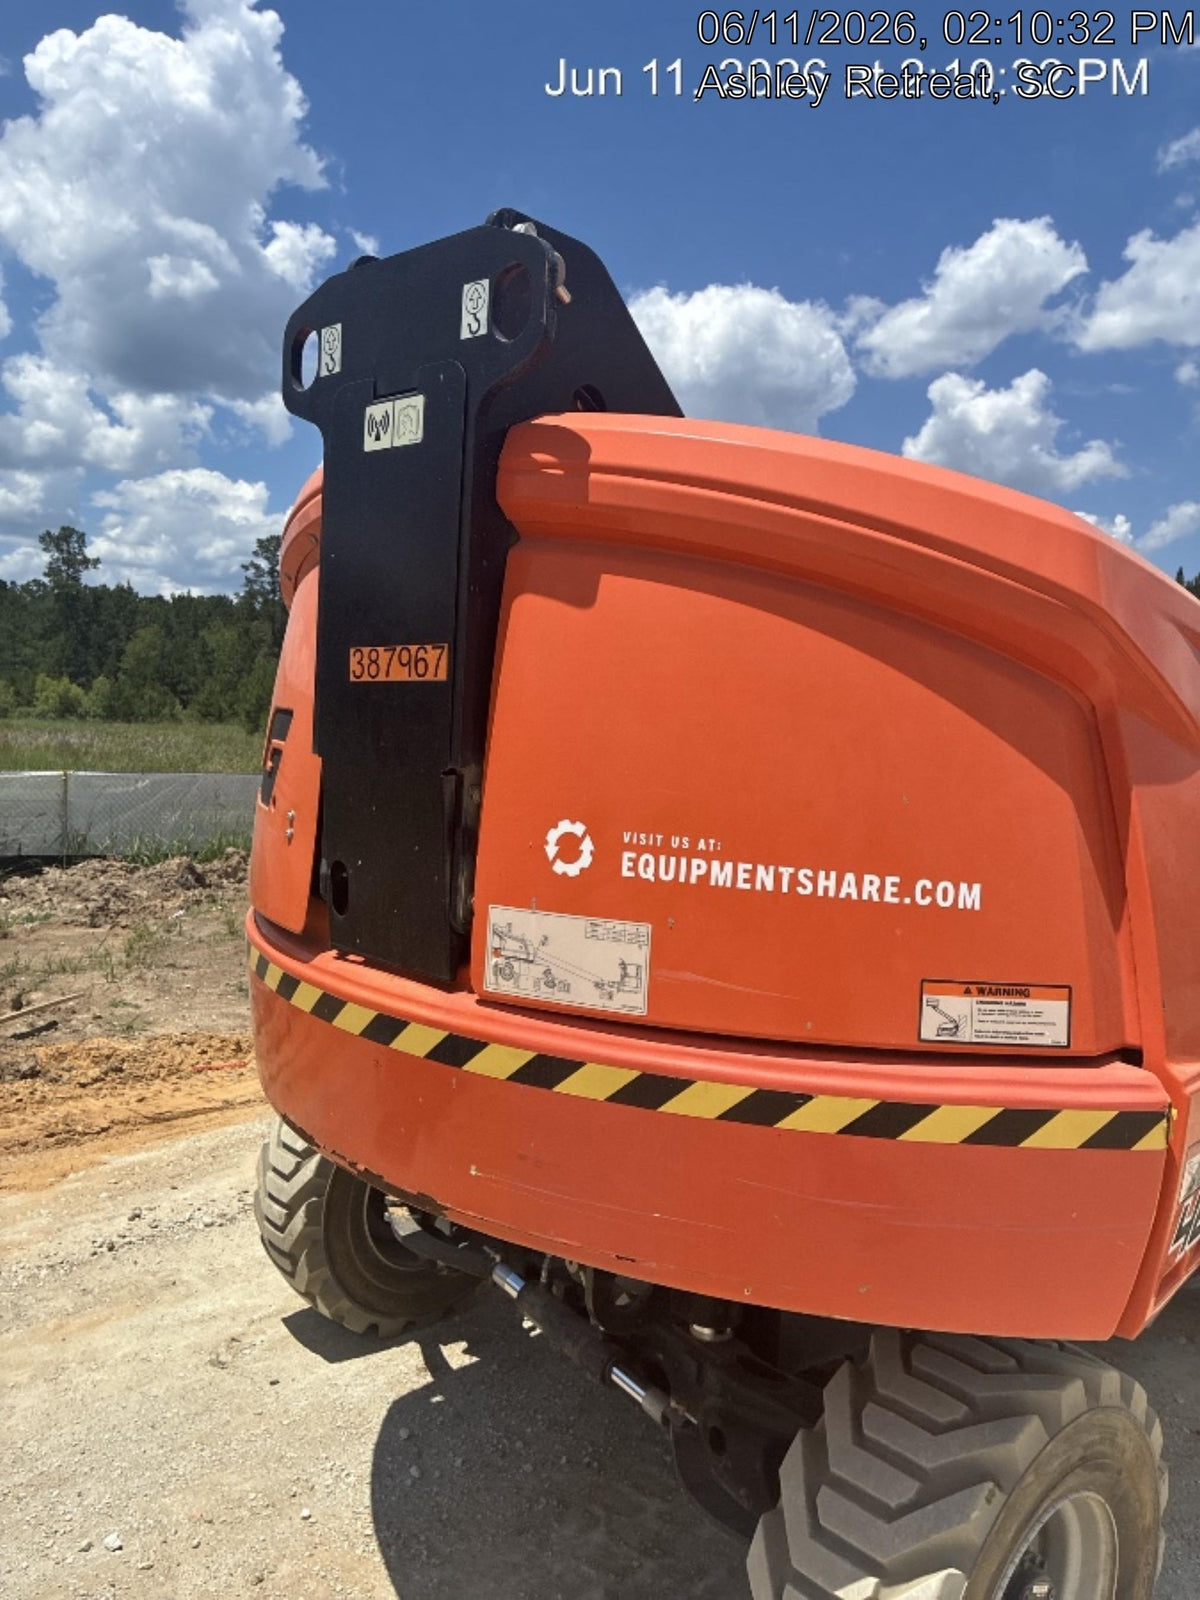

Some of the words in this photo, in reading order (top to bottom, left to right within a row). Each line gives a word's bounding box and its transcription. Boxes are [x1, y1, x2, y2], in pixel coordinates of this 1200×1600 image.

[352, 645, 446, 680] 387967
[622, 831, 664, 848] VISIT
[670, 834, 690, 849] US
[697, 837, 722, 851] AT:
[620, 851, 982, 911] EQUIPMENTSHARE.COM
[976, 986, 1031, 998] WARNING
